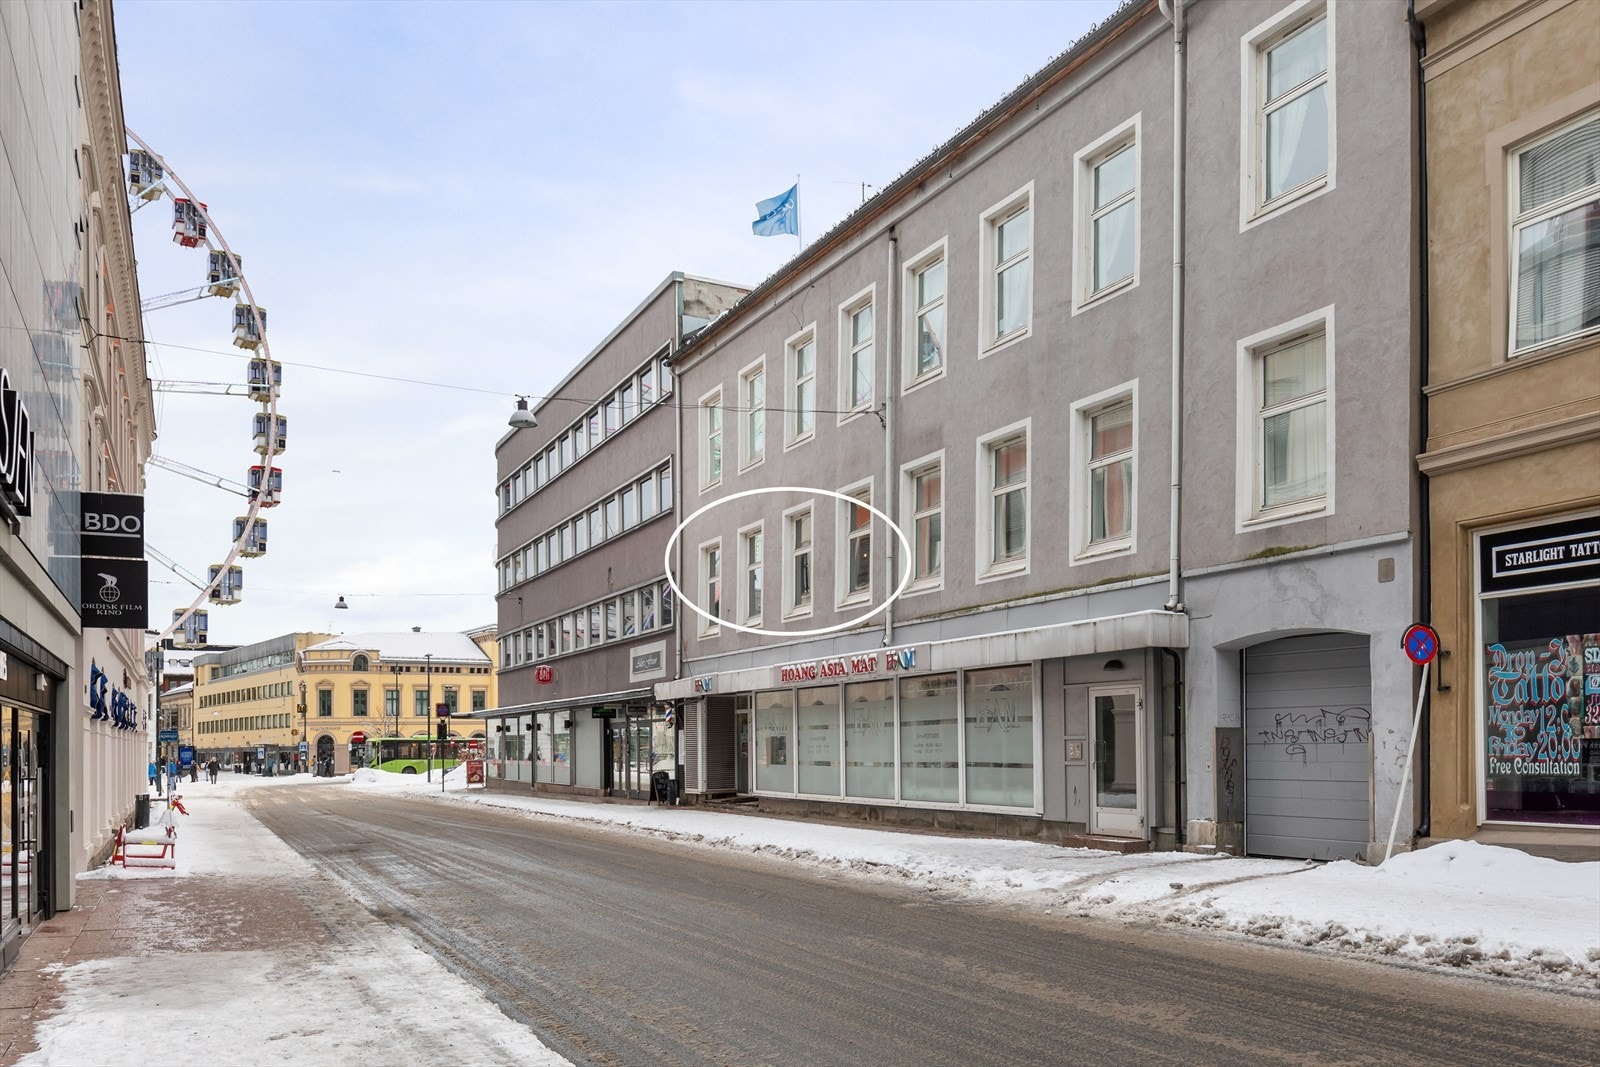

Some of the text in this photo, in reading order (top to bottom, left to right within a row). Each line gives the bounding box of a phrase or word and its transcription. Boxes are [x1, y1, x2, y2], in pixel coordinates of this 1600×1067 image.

[84, 512, 141, 533] BDO
[1504, 541, 1600, 567] STARLIGHT TATT
[780, 662, 817, 683] HOANG
[819, 658, 848, 679] ASIA
[851, 653, 878, 674] MAT
[1488, 663, 1568, 706] Tatto
[1488, 704, 1540, 729] Monday
[1488, 736, 1538, 762] Friday
[1537, 732, 1580, 760] 20:00
[1489, 757, 1580, 775] Free Consultation
